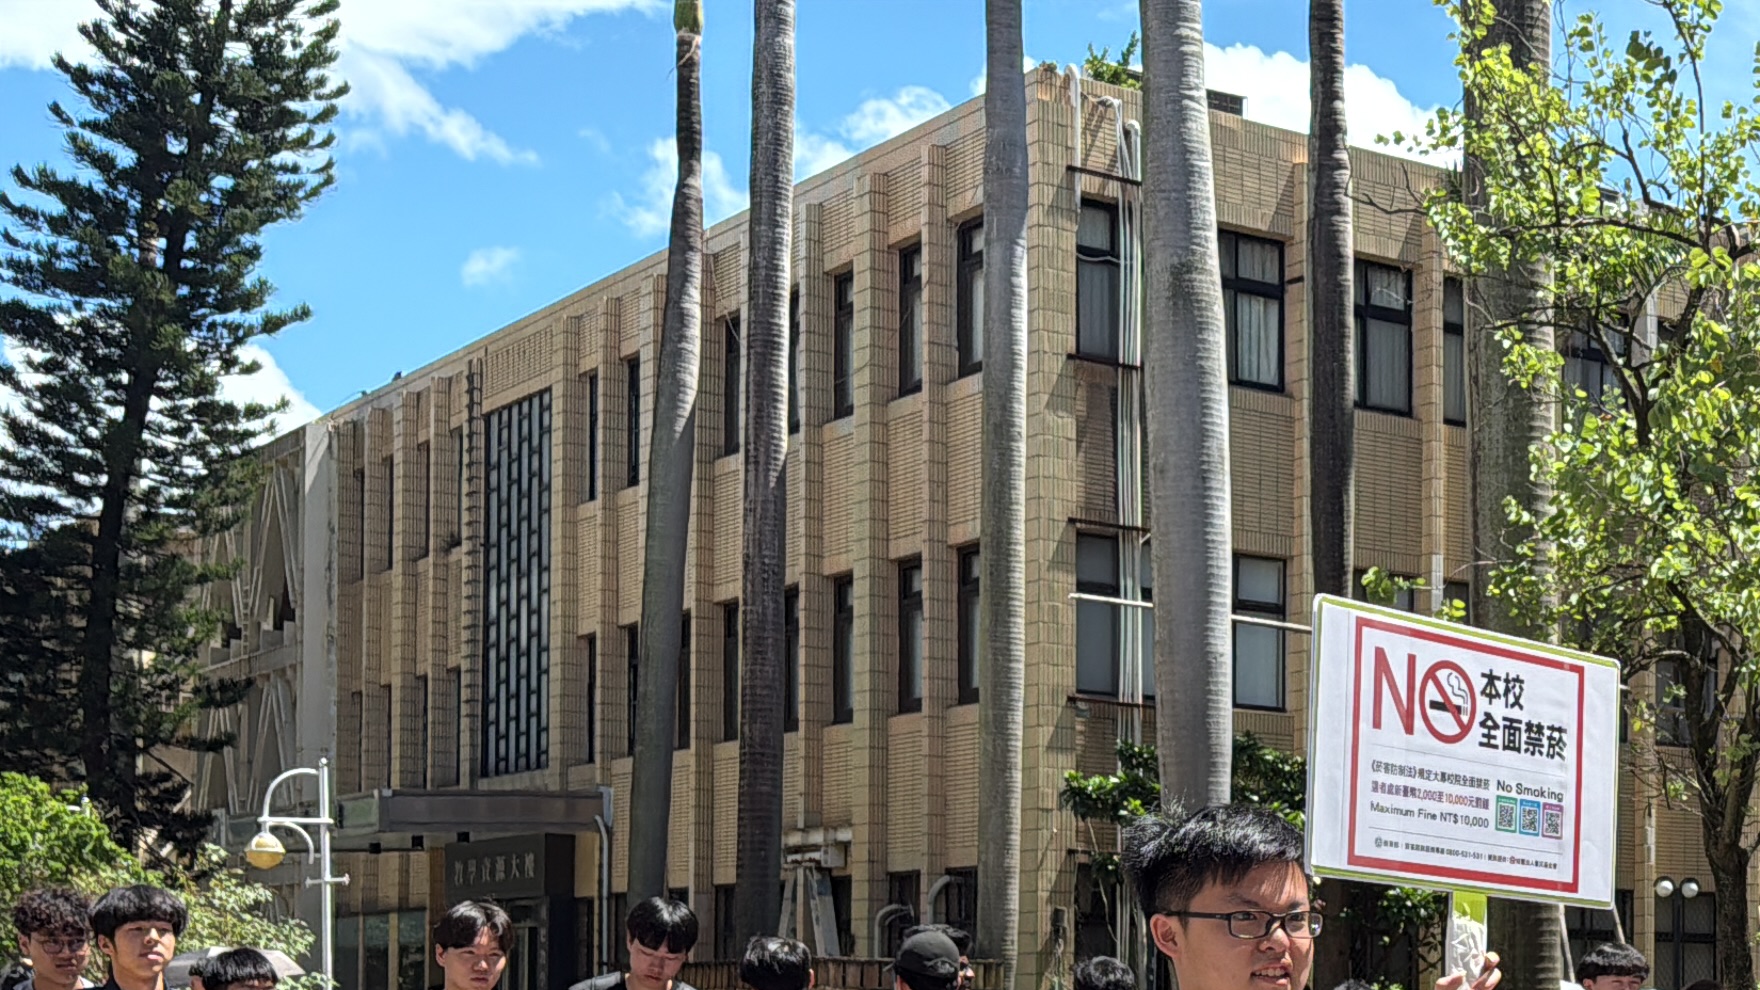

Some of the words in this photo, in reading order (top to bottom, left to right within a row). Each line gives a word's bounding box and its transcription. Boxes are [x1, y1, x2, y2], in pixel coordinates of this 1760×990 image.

[1481, 669, 1525, 711] 本校
[1478, 712, 1567, 762] 全面禁菸
[1496, 779, 1513, 793] No
[1516, 782, 1564, 803] Smoking
[1370, 800, 1415, 818] Maximum
[1417, 807, 1437, 821] Fine
